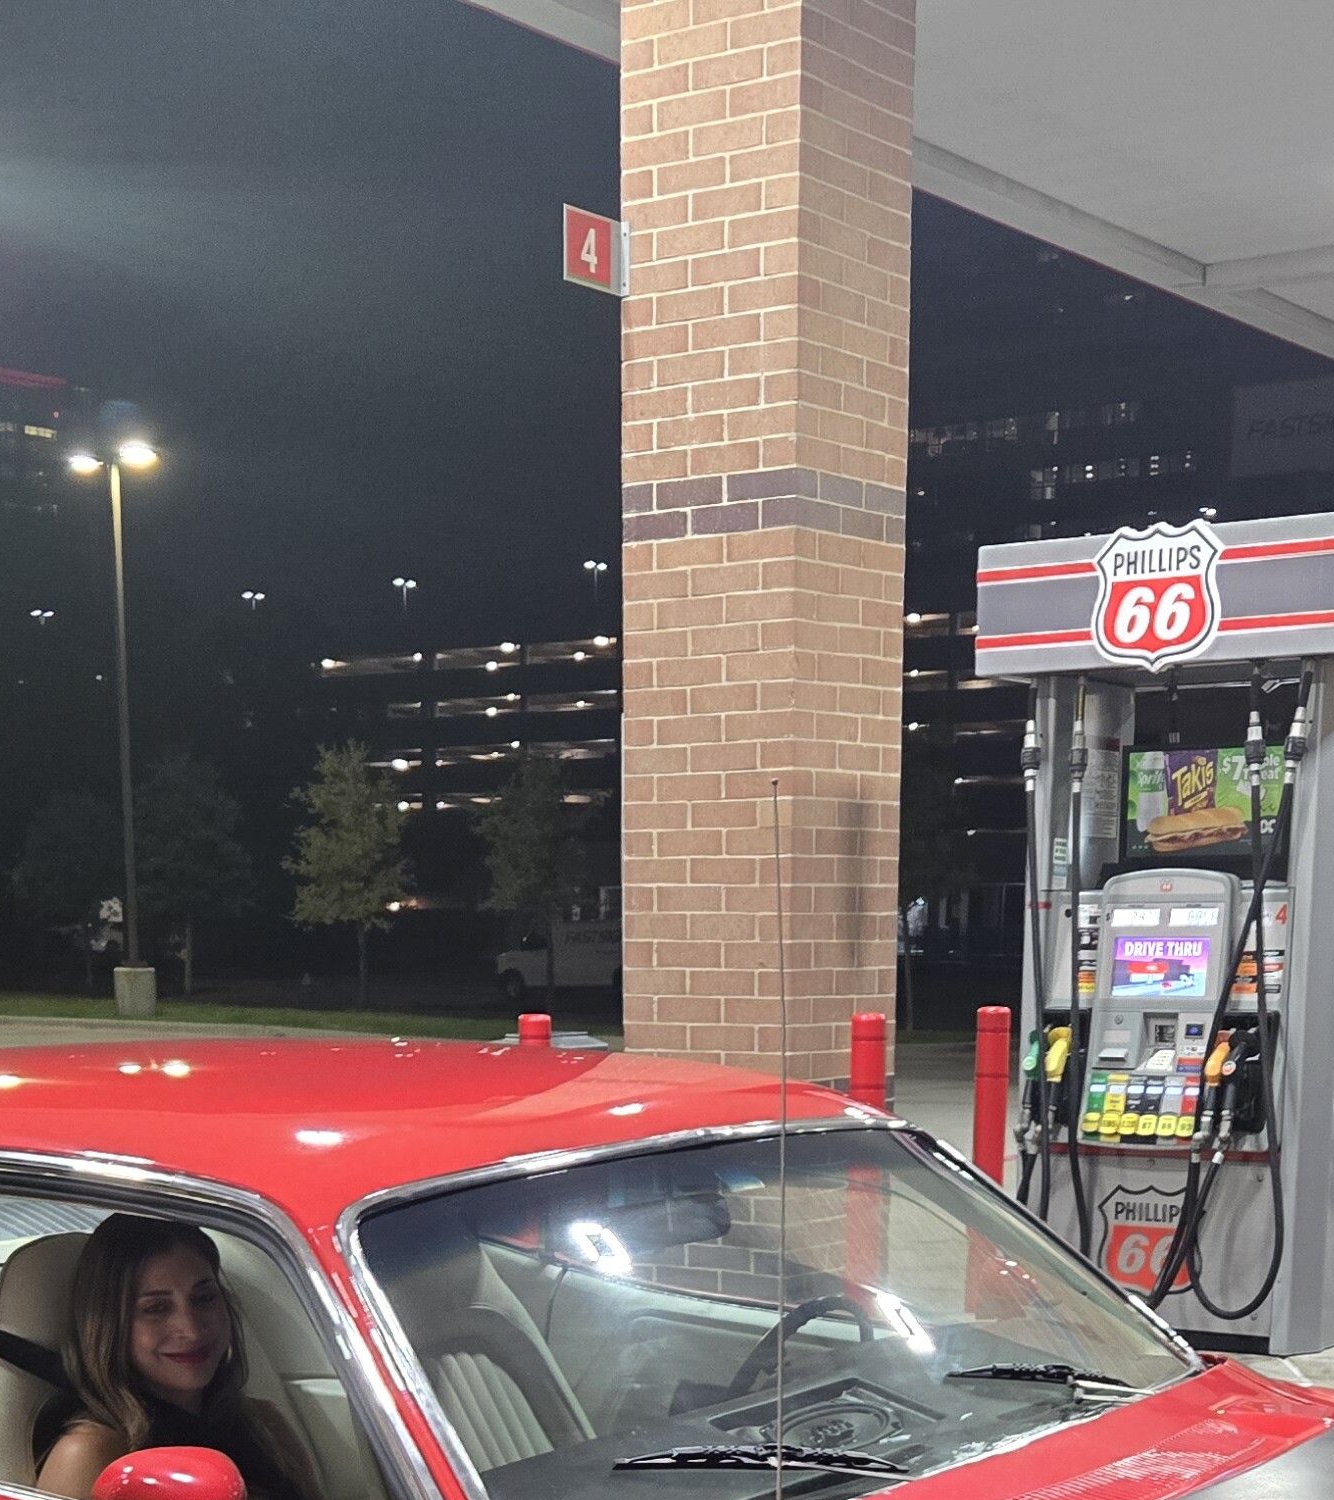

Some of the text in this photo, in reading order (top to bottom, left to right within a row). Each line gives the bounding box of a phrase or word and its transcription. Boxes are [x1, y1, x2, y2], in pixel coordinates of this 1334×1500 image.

[580, 227, 598, 274] 4
[1113, 544, 1202, 577] PHILLIPS
[1113, 582, 1196, 644] 66
[1171, 760, 1215, 807] Takis
[1275, 903, 1289, 926] 4
[1124, 941, 1203, 957] DRIVE THRU
[1114, 1201, 1181, 1224] PHILLIP
